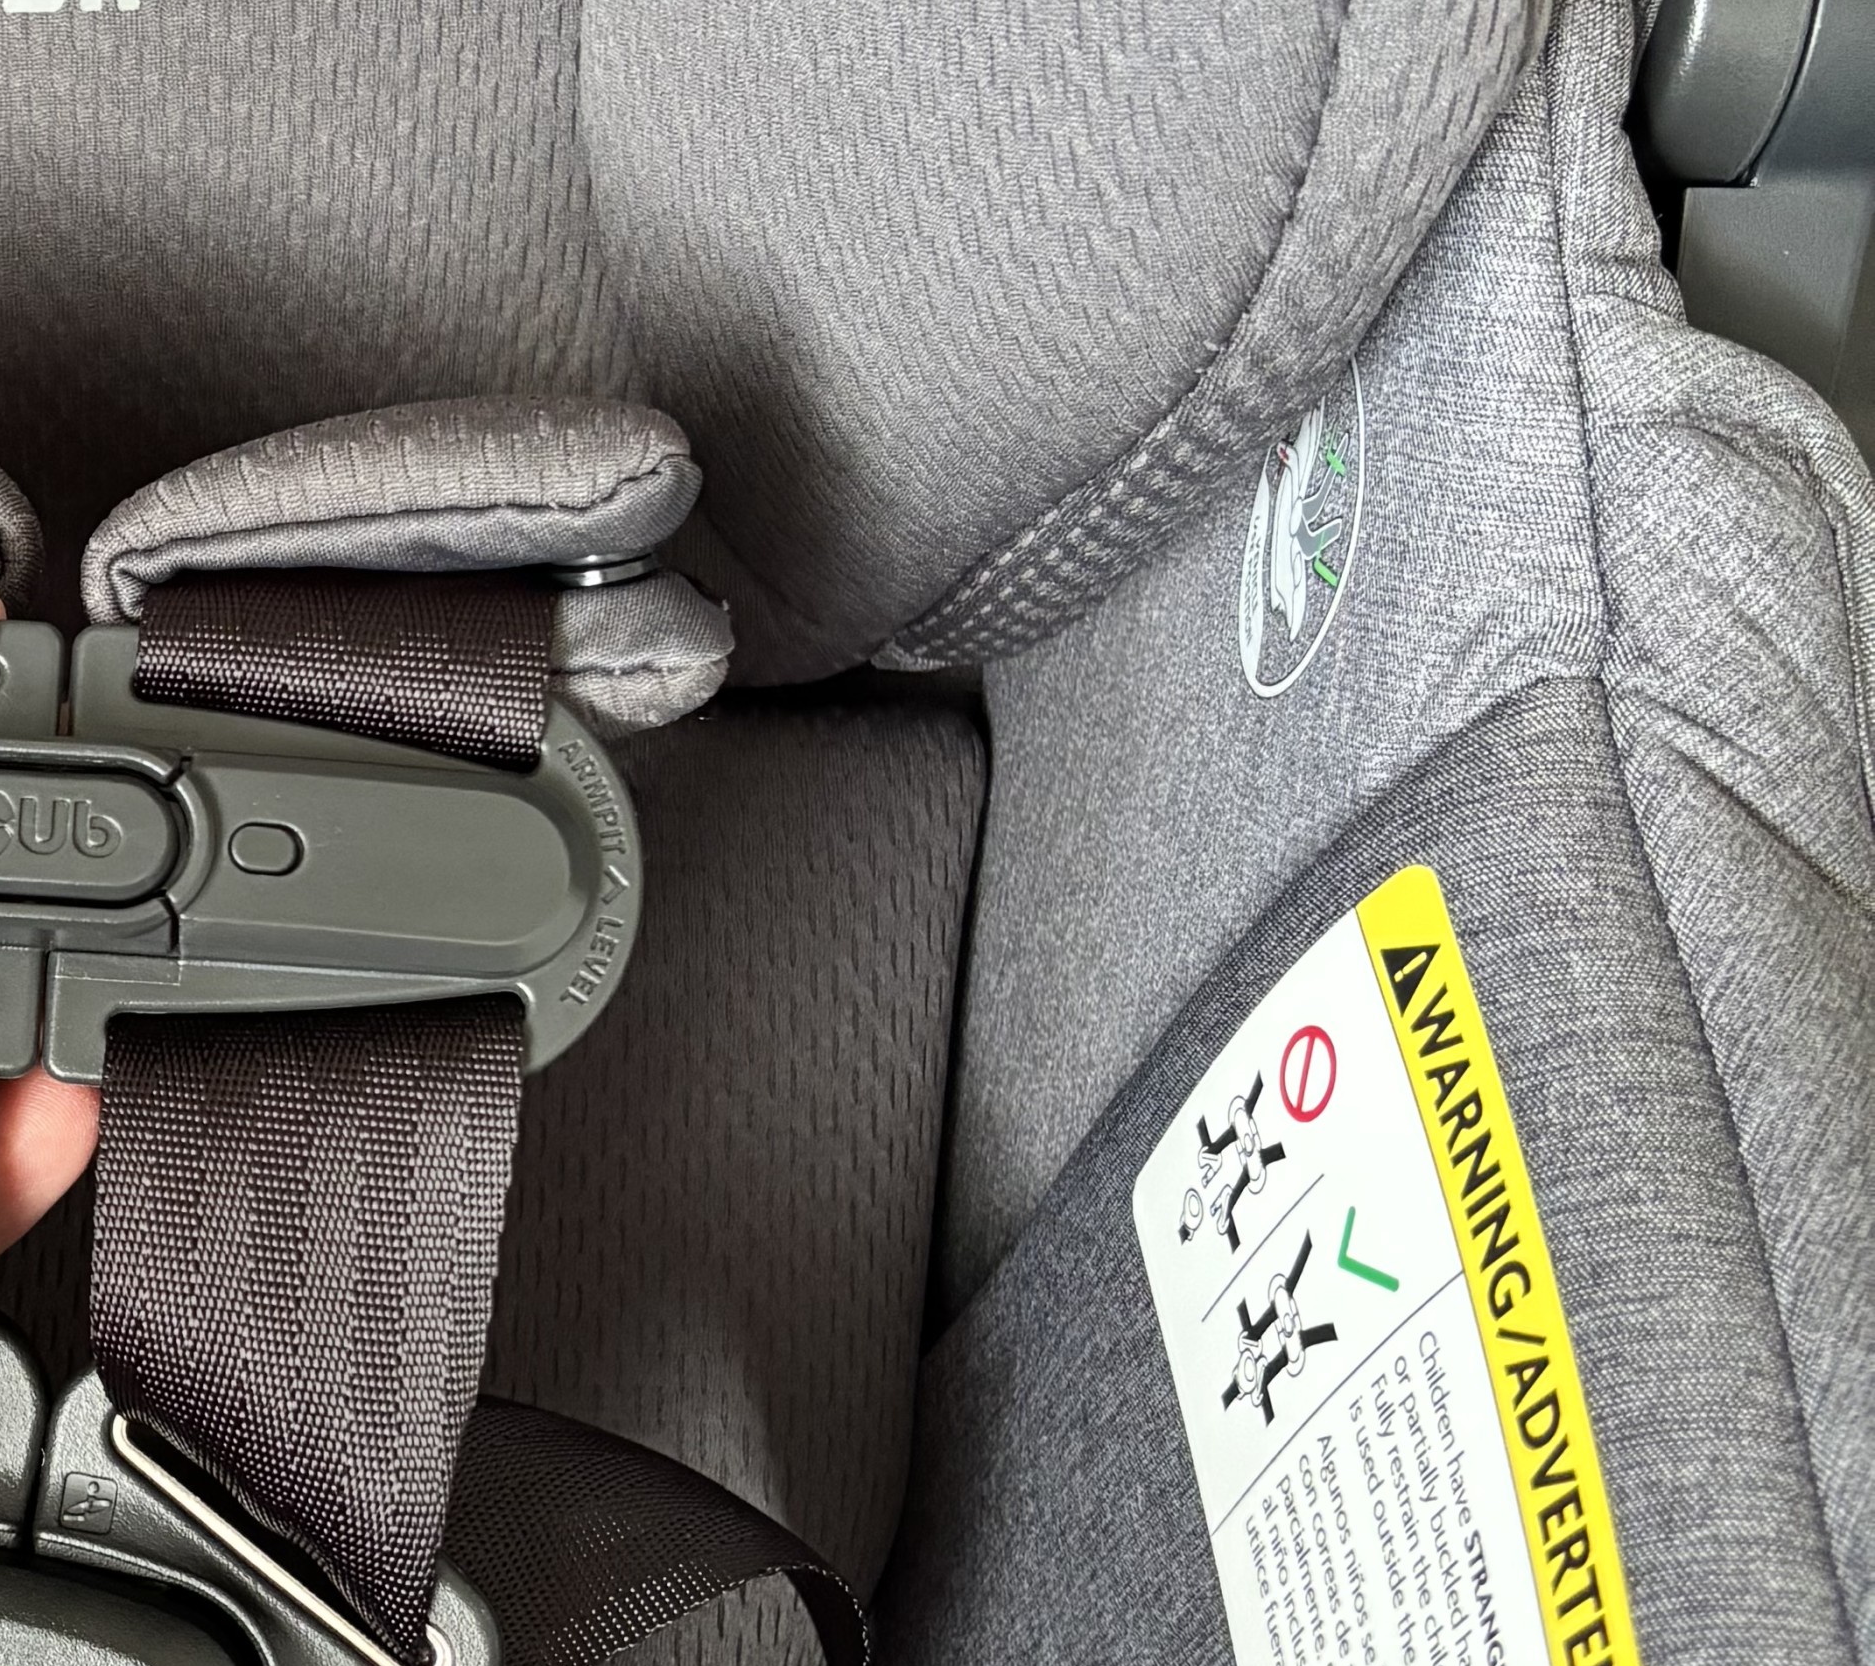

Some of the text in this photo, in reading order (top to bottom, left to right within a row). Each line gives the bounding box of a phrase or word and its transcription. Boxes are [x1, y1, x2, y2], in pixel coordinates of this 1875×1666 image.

[18, 796, 124, 859] Ub
[558, 738, 627, 1005] ARMPIT LEVEL
[1394, 1355, 1411, 1384] or
[1397, 1391, 1439, 1502] partially
[1418, 1330, 1455, 1452] Children
[1446, 1449, 1471, 1527] have
[1245, 1514, 1269, 1598] utilice
[1261, 1495, 1278, 1521] al
[1268, 1523, 1288, 1586] niño
[1275, 1473, 1325, 1660] parcialmente.
[1298, 1453, 1317, 1507] con
[1312, 1511, 1341, 1614] correas
[1334, 1619, 1351, 1658] de
[1316, 1434, 1351, 1545] Algunos
[1343, 1548, 1368, 1627] niños
[1361, 1631, 1376, 1665] se
[1348, 1395, 1362, 1422] is
[1355, 1425, 1384, 1495] used
[1373, 1499, 1406, 1608] outside
[1397, 1612, 1416, 1666] the
[1370, 1372, 1396, 1437] Fully
[1387, 1444, 1419, 1552] restrain
[1412, 1554, 1431, 1608] the
[1429, 1504, 1469, 1630] buckled
